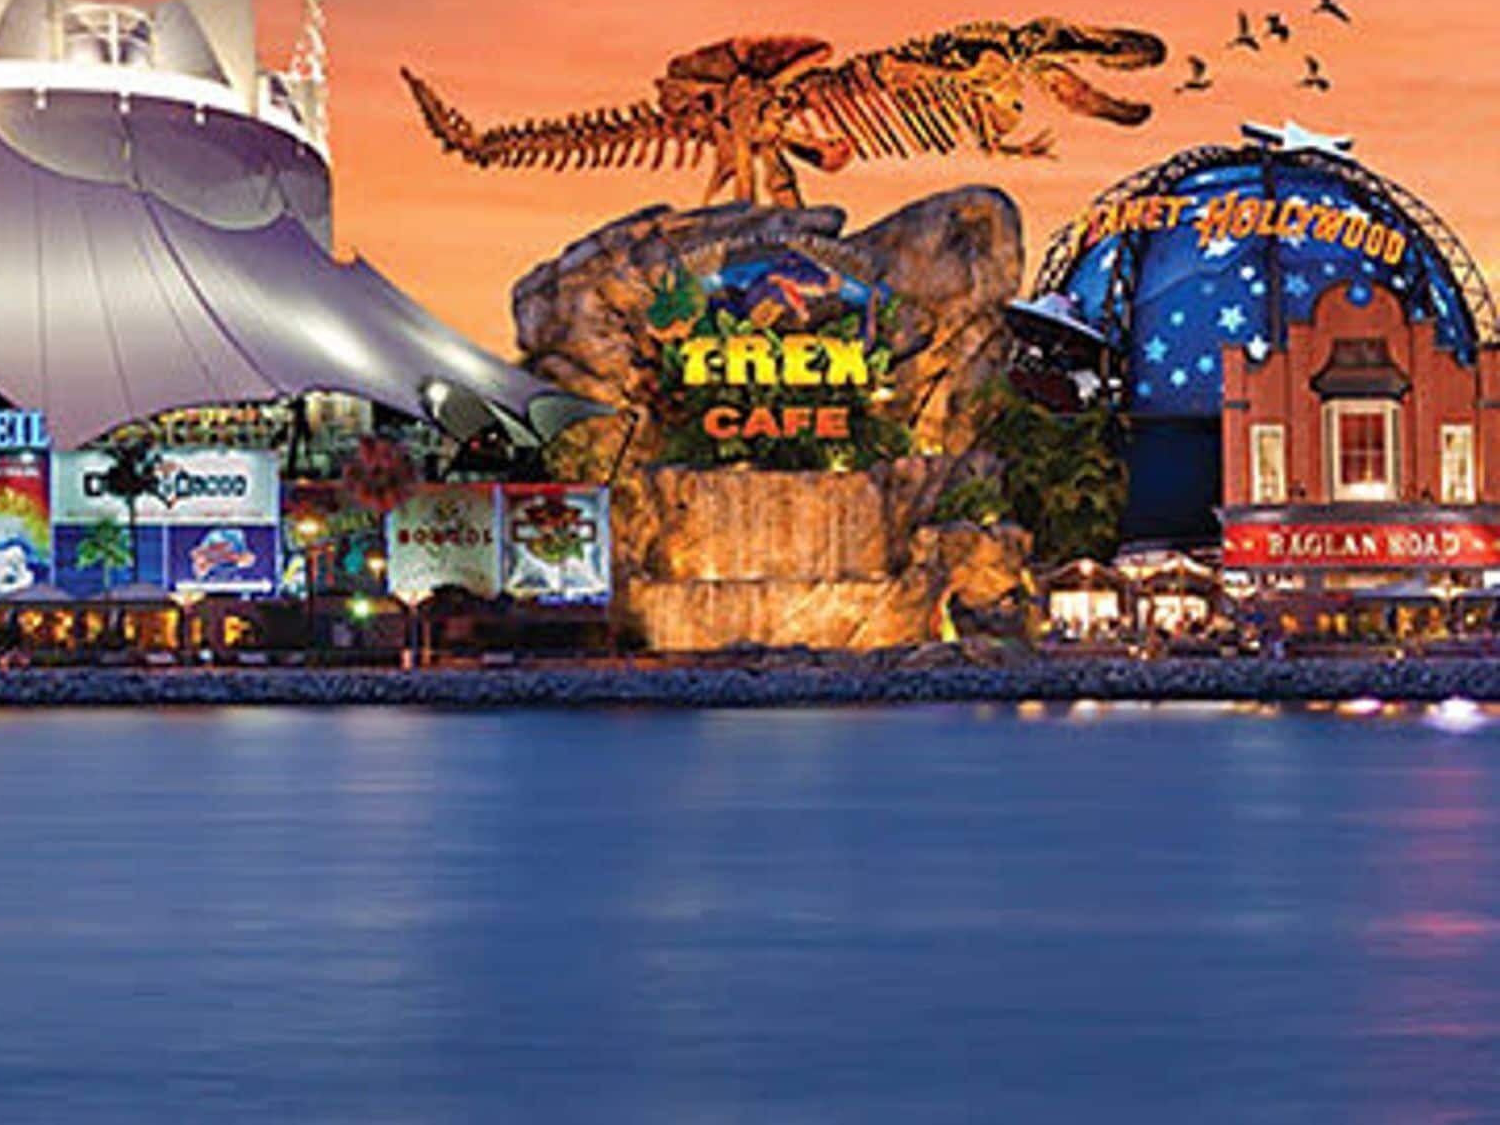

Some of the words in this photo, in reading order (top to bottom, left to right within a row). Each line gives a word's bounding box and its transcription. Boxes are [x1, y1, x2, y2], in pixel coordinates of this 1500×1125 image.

[1193, 190, 1407, 266] HOLLYWOOD
[703, 405, 850, 438] CAFE
[1267, 531, 1377, 557] RAGLAN
[1386, 531, 1461, 557] ROAD
